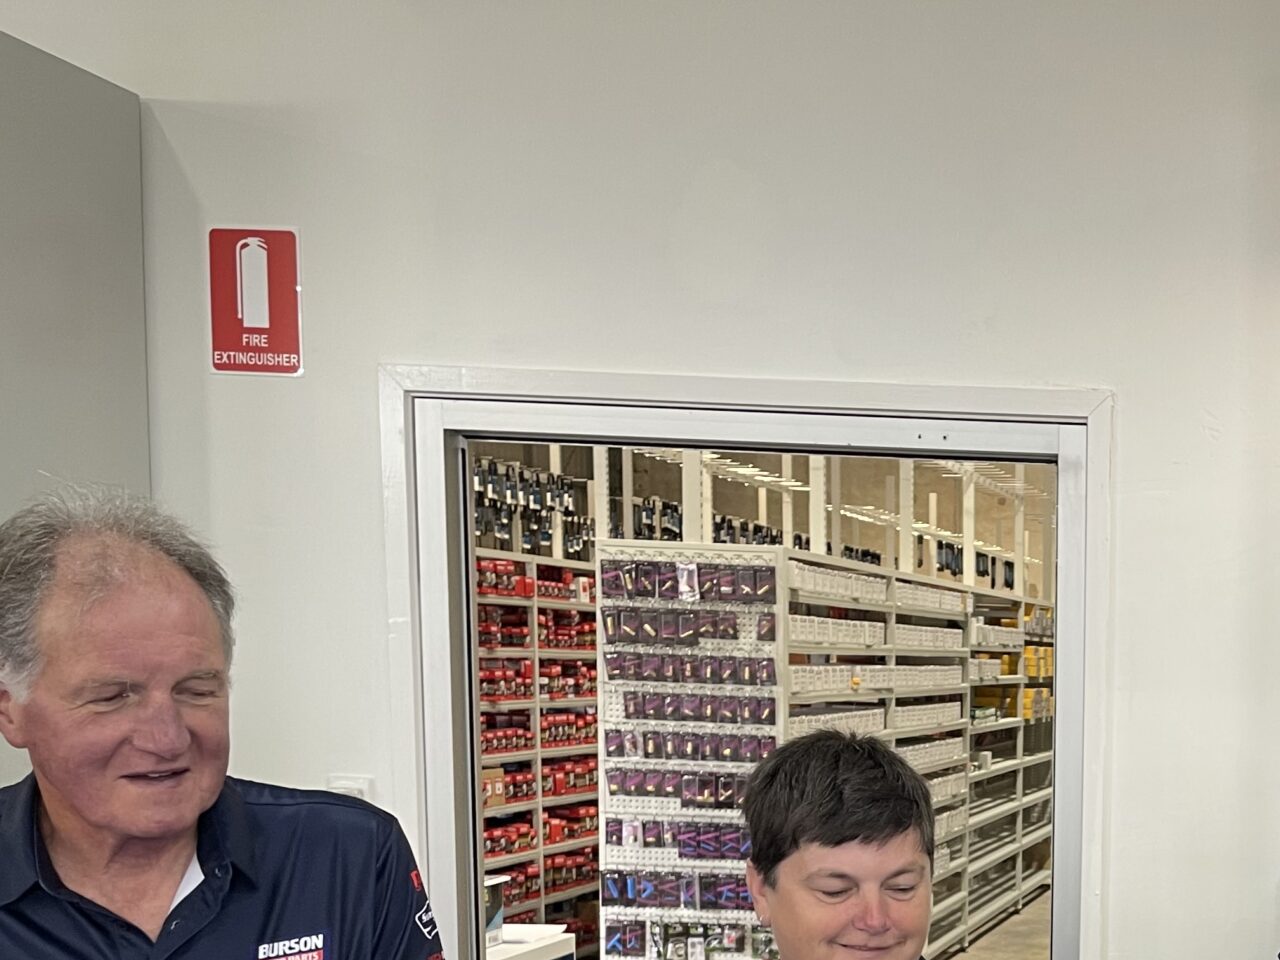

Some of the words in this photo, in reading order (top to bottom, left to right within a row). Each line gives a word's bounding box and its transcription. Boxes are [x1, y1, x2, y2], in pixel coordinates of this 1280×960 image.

[242, 334, 268, 347] FIRE
[214, 351, 298, 366] EXTINGUISHER
[258, 933, 324, 959] BURSON
